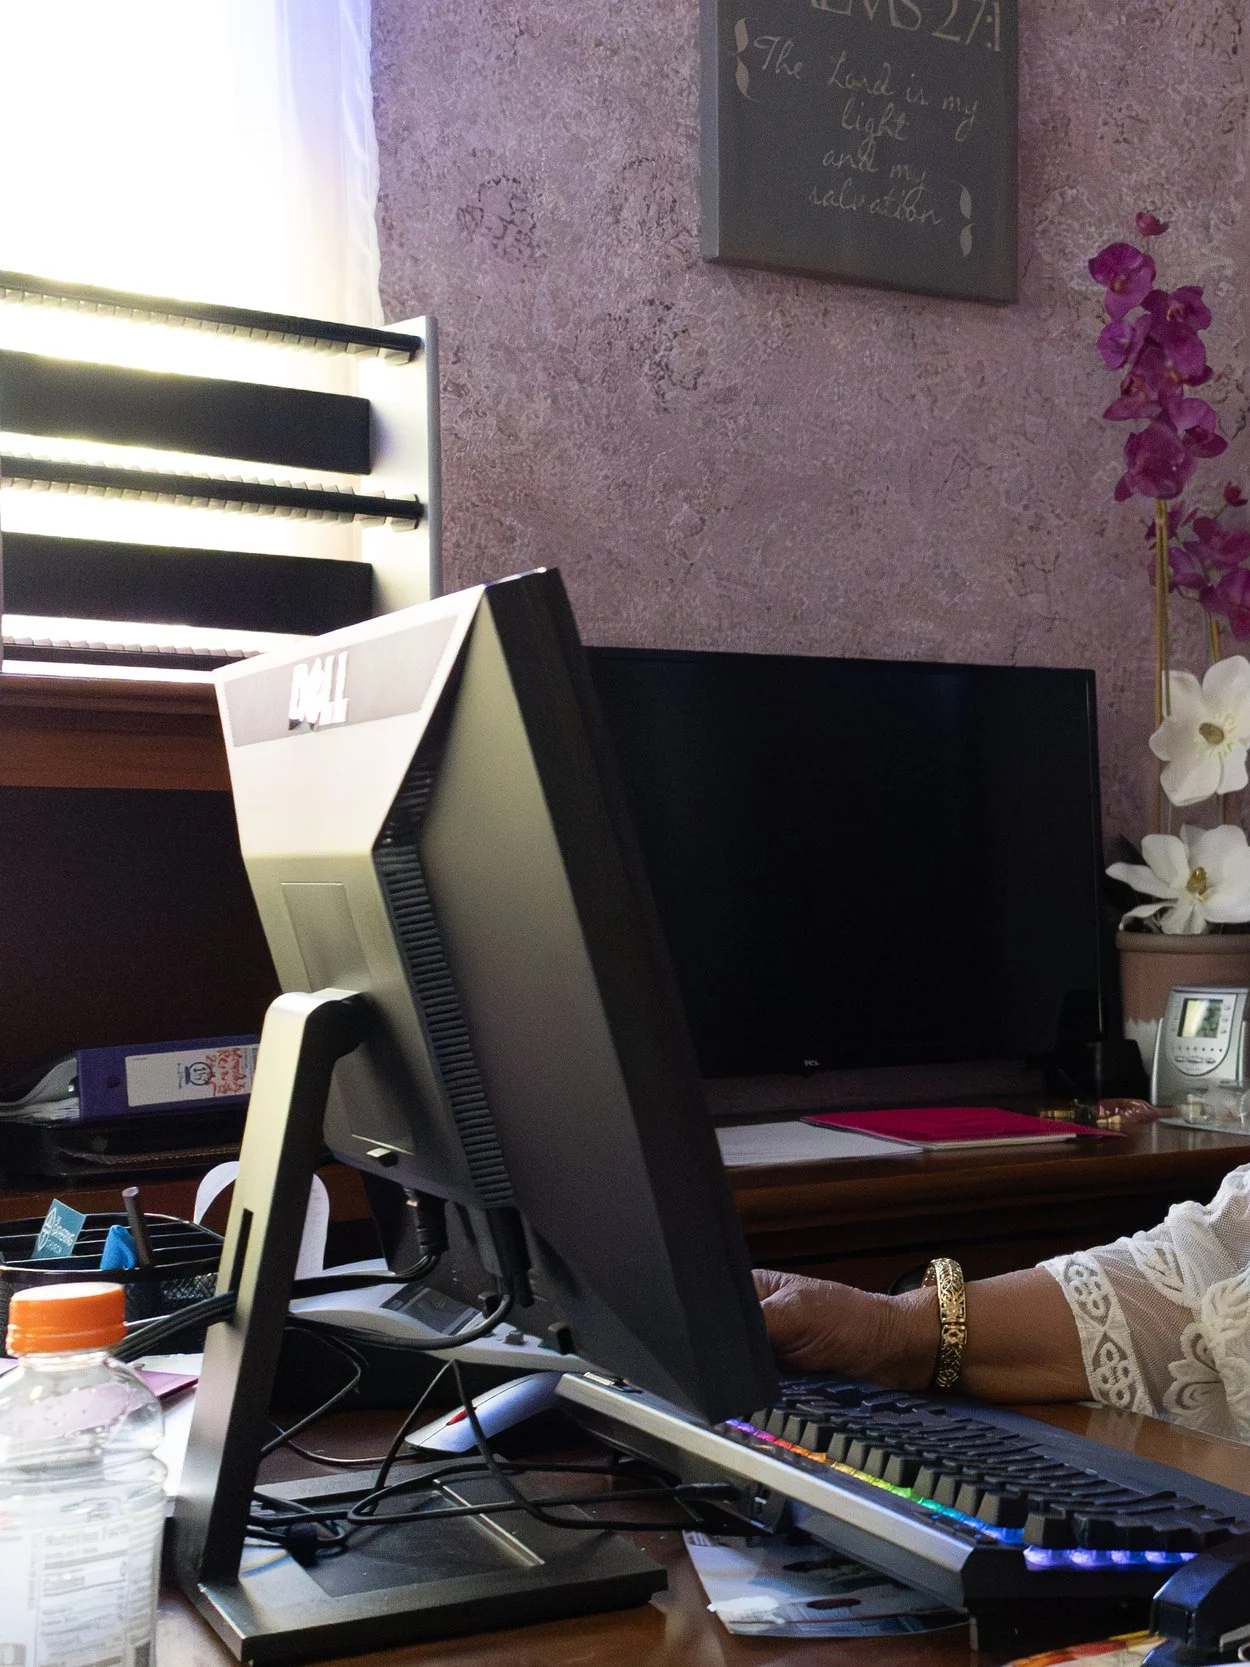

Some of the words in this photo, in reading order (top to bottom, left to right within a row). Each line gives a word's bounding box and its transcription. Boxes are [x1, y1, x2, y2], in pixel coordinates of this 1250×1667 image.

[753, 35, 804, 79] The
[827, 50, 894, 96] Lord
[906, 73, 928, 106] is
[942, 95, 978, 142] my
[841, 96, 910, 160] light
[808, 177, 943, 225] salvation
[822, 140, 880, 173] and
[890, 165, 926, 208] my
[287, 650, 349, 727] DELL
